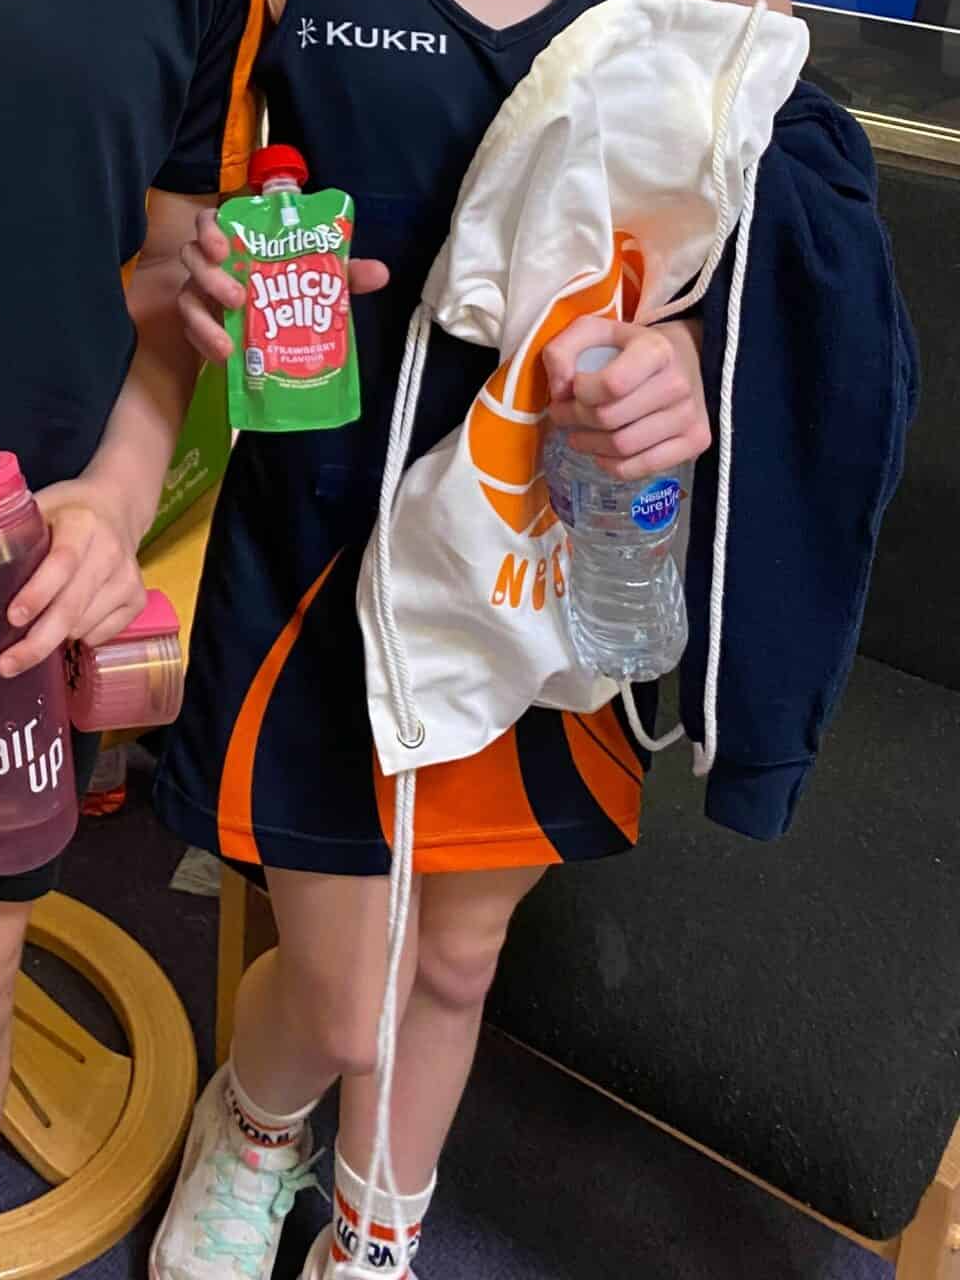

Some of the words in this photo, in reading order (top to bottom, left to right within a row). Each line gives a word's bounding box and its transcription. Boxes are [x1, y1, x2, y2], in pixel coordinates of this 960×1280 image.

[326, 21, 448, 55] KUKRI
[248, 224, 343, 258] Hartley's
[250, 263, 342, 309] Juicy
[267, 341, 337, 356] STRAWBERRY
[631, 500, 664, 518] Pure
[28, 736, 64, 793] up
